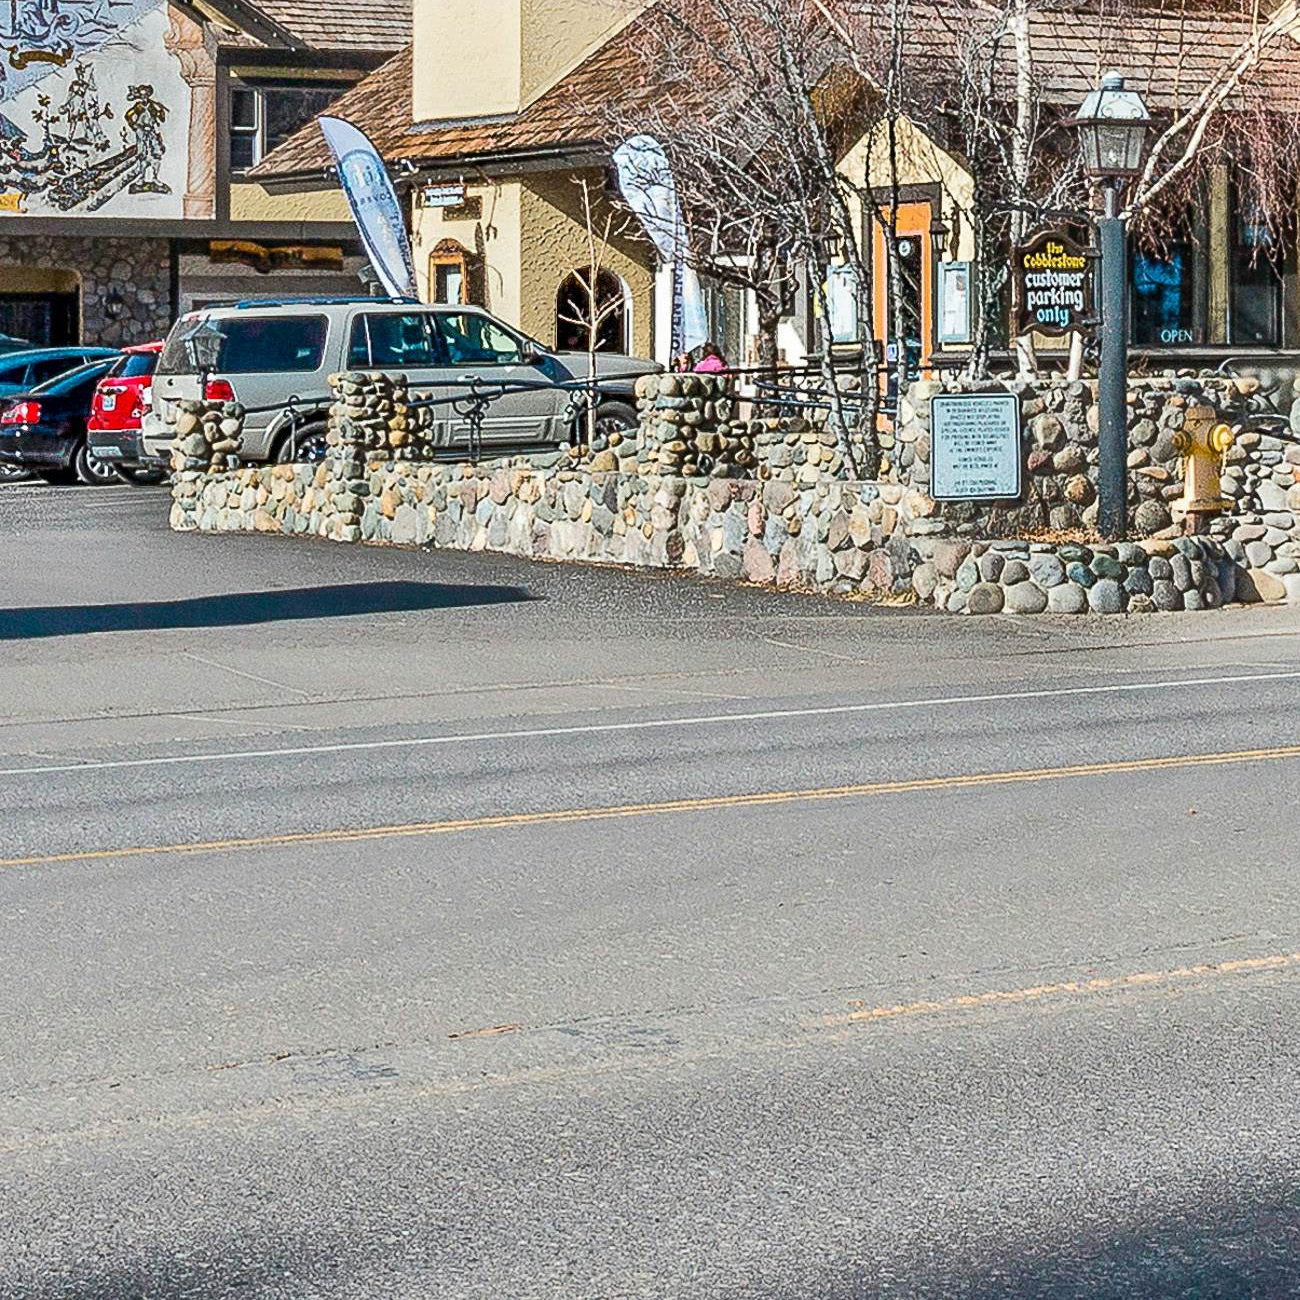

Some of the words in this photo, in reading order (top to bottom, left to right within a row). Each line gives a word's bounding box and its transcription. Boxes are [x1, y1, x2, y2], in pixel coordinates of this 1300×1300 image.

[1047, 241, 1064, 254] the
[1023, 253, 1086, 269] Cobblestone
[1025, 269, 1085, 288] customer
[1027, 286, 1084, 312] parking
[1037, 305, 1070, 327] only
[1160, 329, 1193, 343] OPEN
